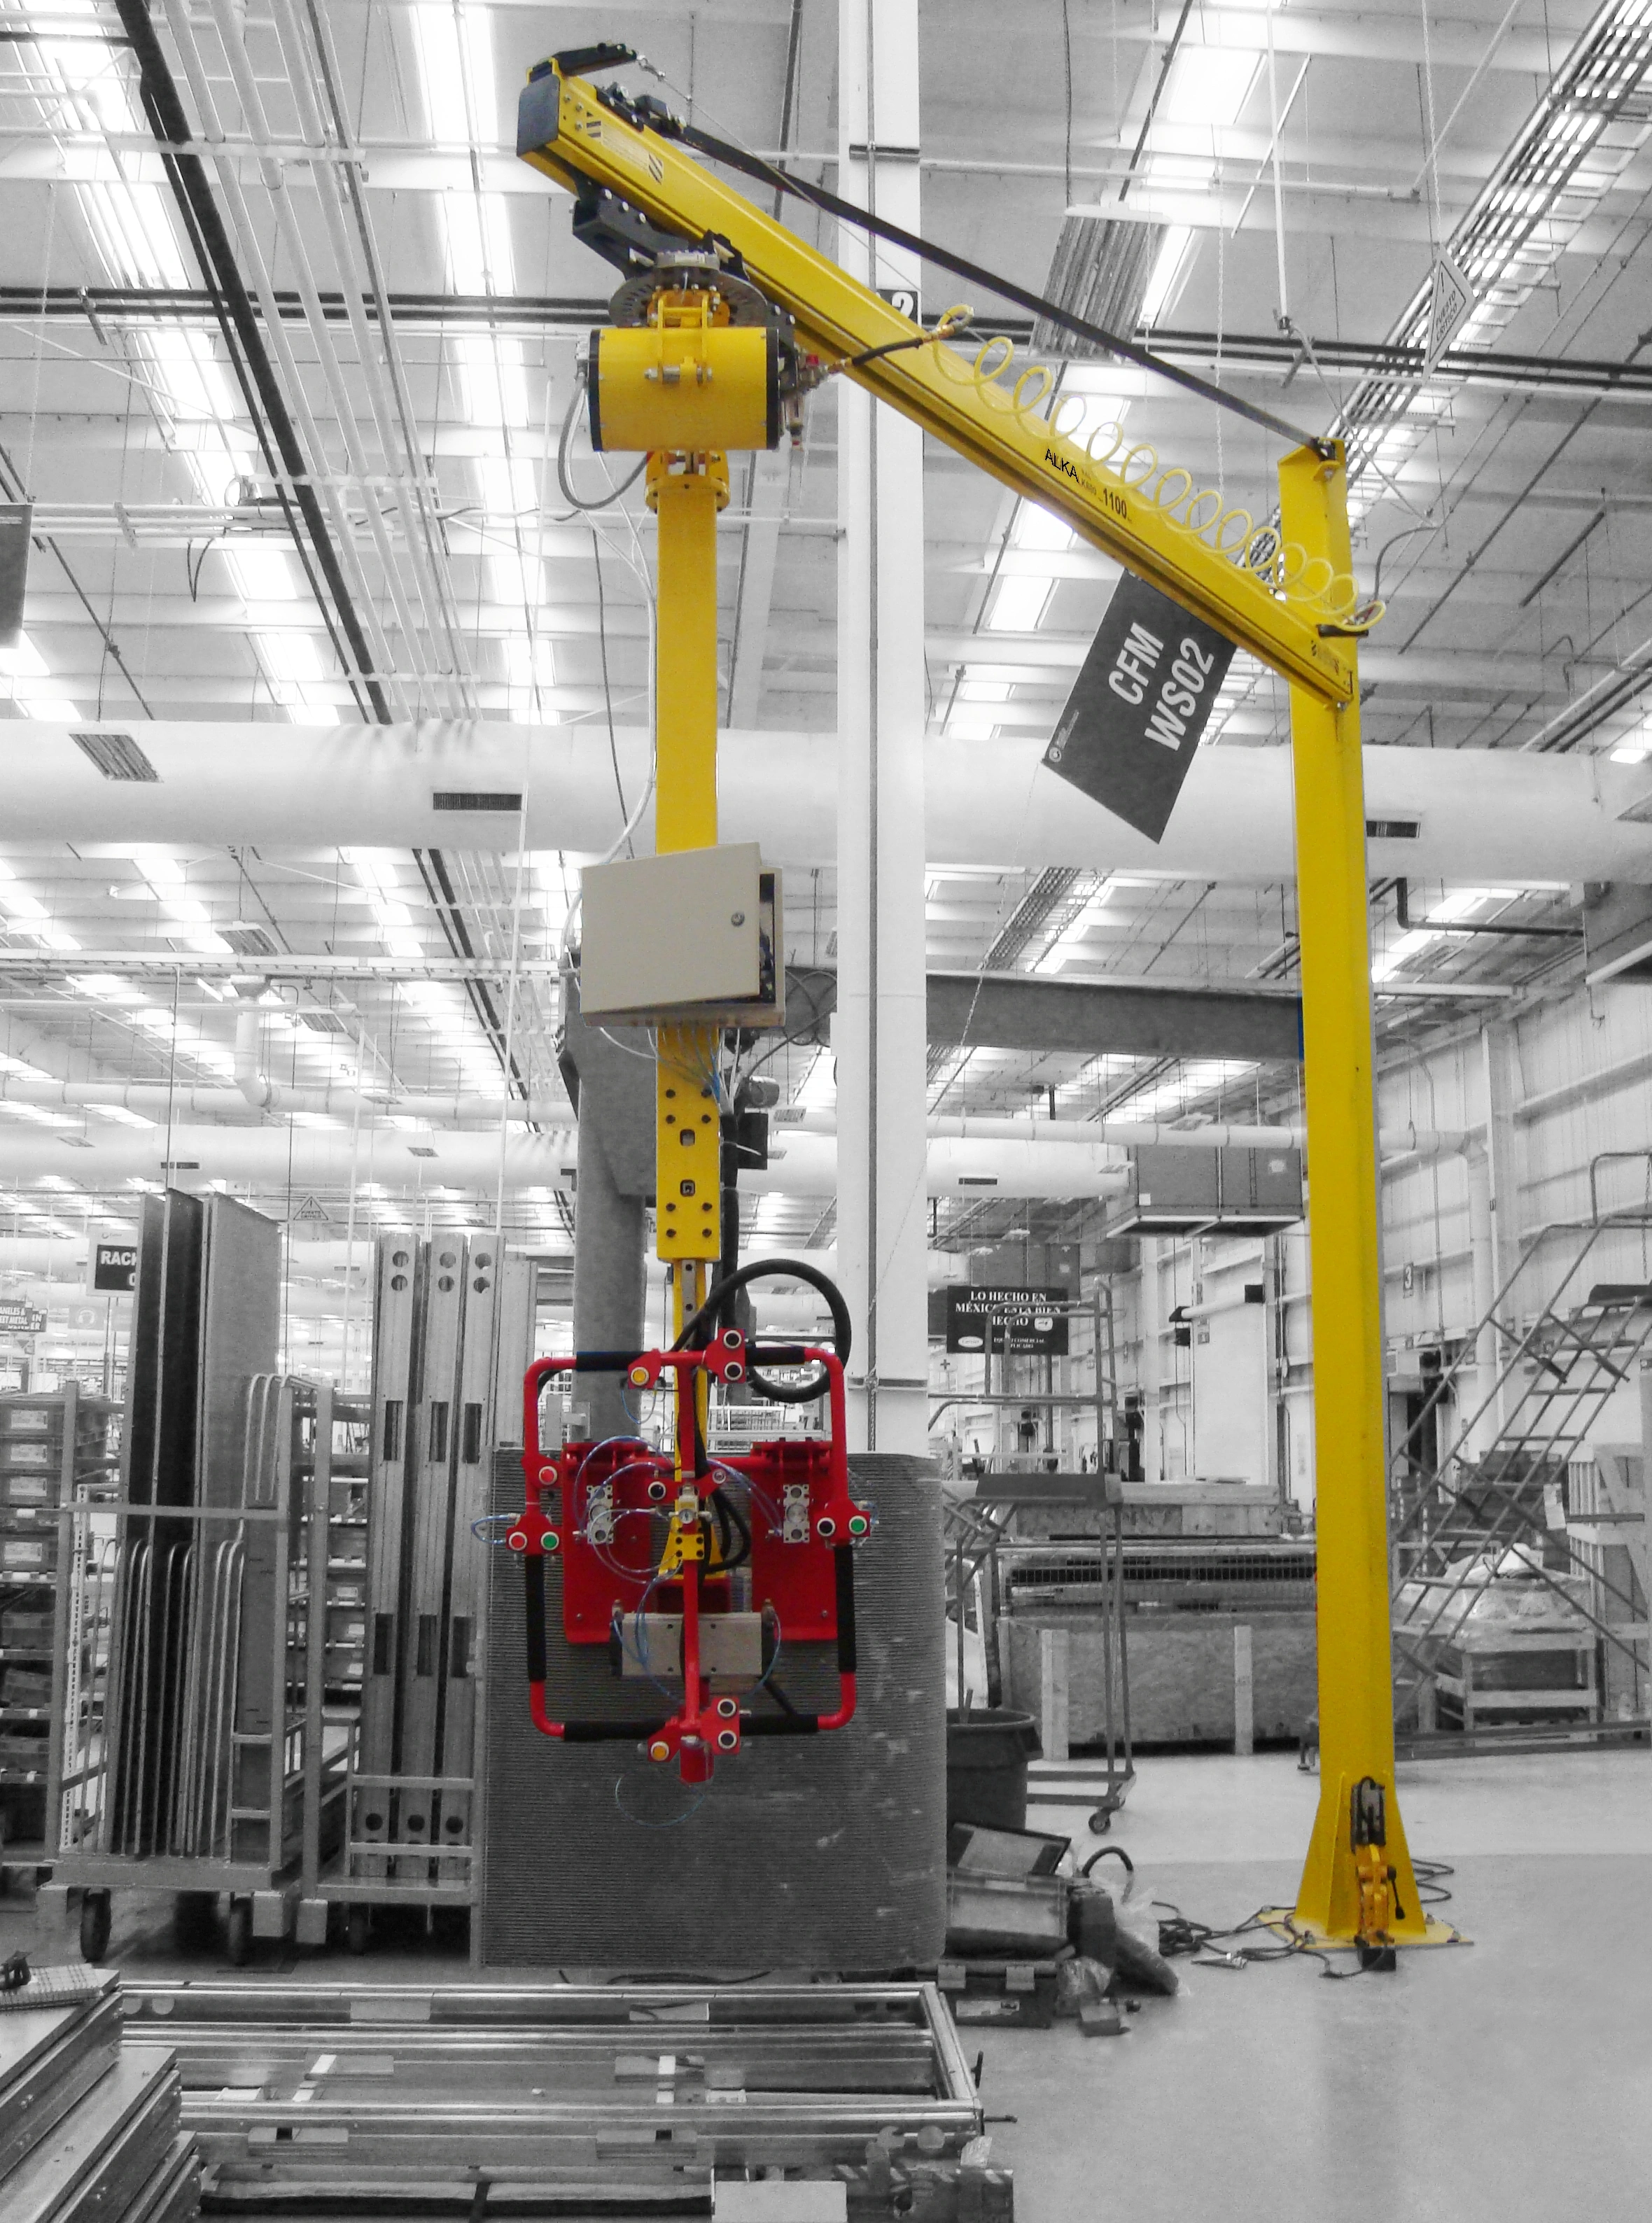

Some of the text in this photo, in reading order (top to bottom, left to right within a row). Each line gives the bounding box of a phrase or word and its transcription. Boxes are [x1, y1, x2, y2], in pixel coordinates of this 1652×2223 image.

[1103, 488, 1127, 519] 1100
[1108, 622, 1164, 705] CFM
[1405, 1265, 1412, 1289] 3
[970, 1290, 1046, 1303] LO HECHO EN
